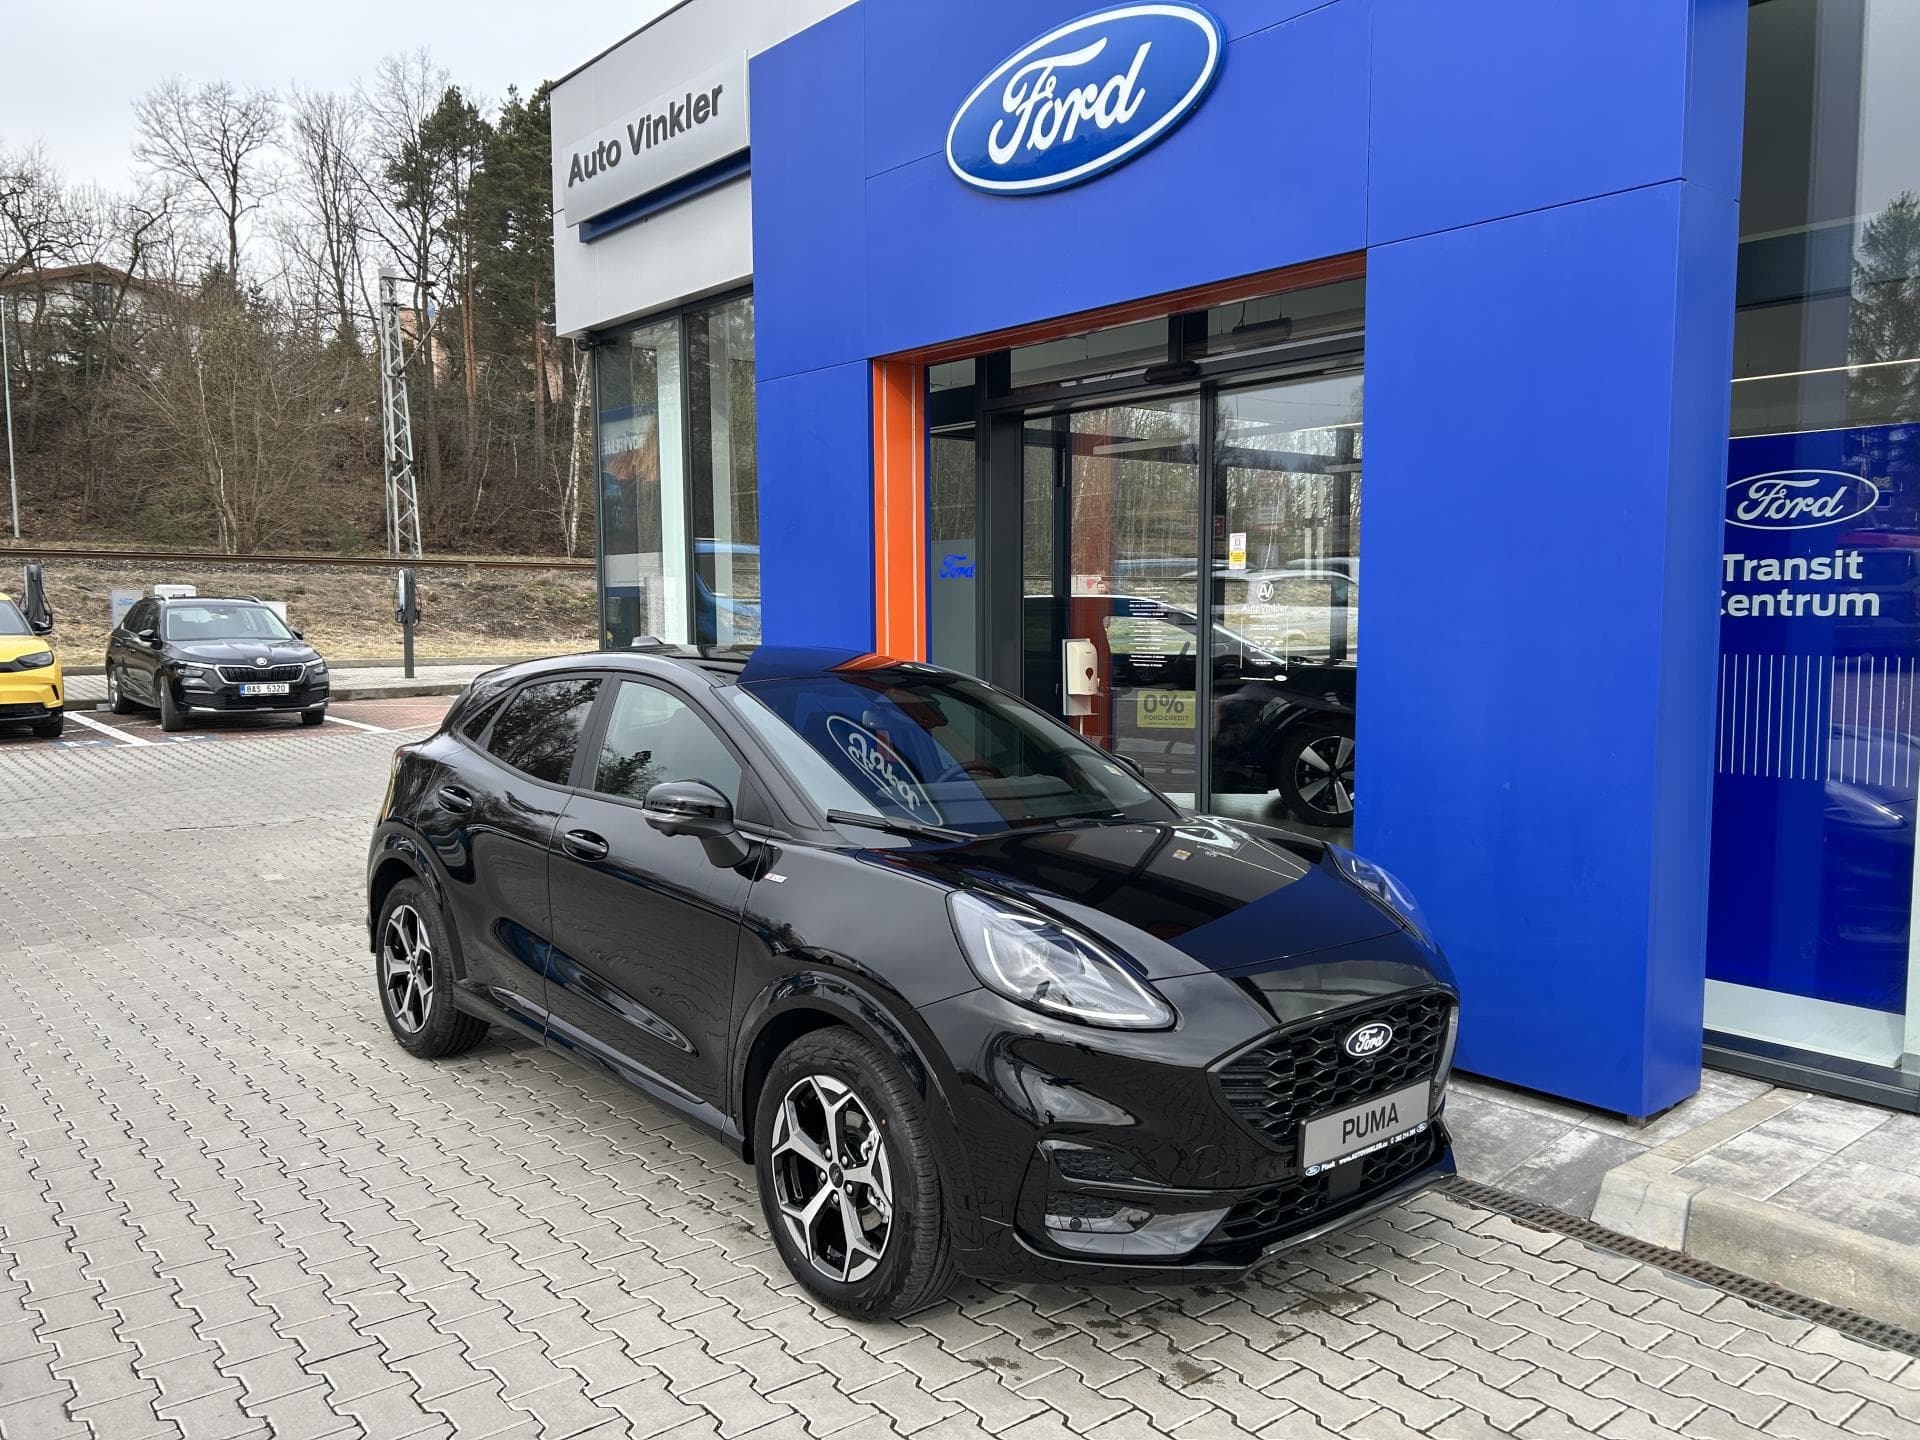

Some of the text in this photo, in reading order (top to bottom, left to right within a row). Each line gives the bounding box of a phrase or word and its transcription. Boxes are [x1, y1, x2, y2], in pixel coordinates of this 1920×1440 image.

[988, 36, 1152, 165] Ford
[568, 84, 723, 188] Auto Vinkler
[1736, 478, 1848, 521] Ford
[1723, 549, 1864, 582] Transit
[1720, 588, 1880, 617] entrum
[266, 684, 286, 693] 5320
[1144, 694, 1185, 714] 0%
[1355, 1028, 1385, 1053] Ford
[1342, 1102, 1399, 1144] PUMA
